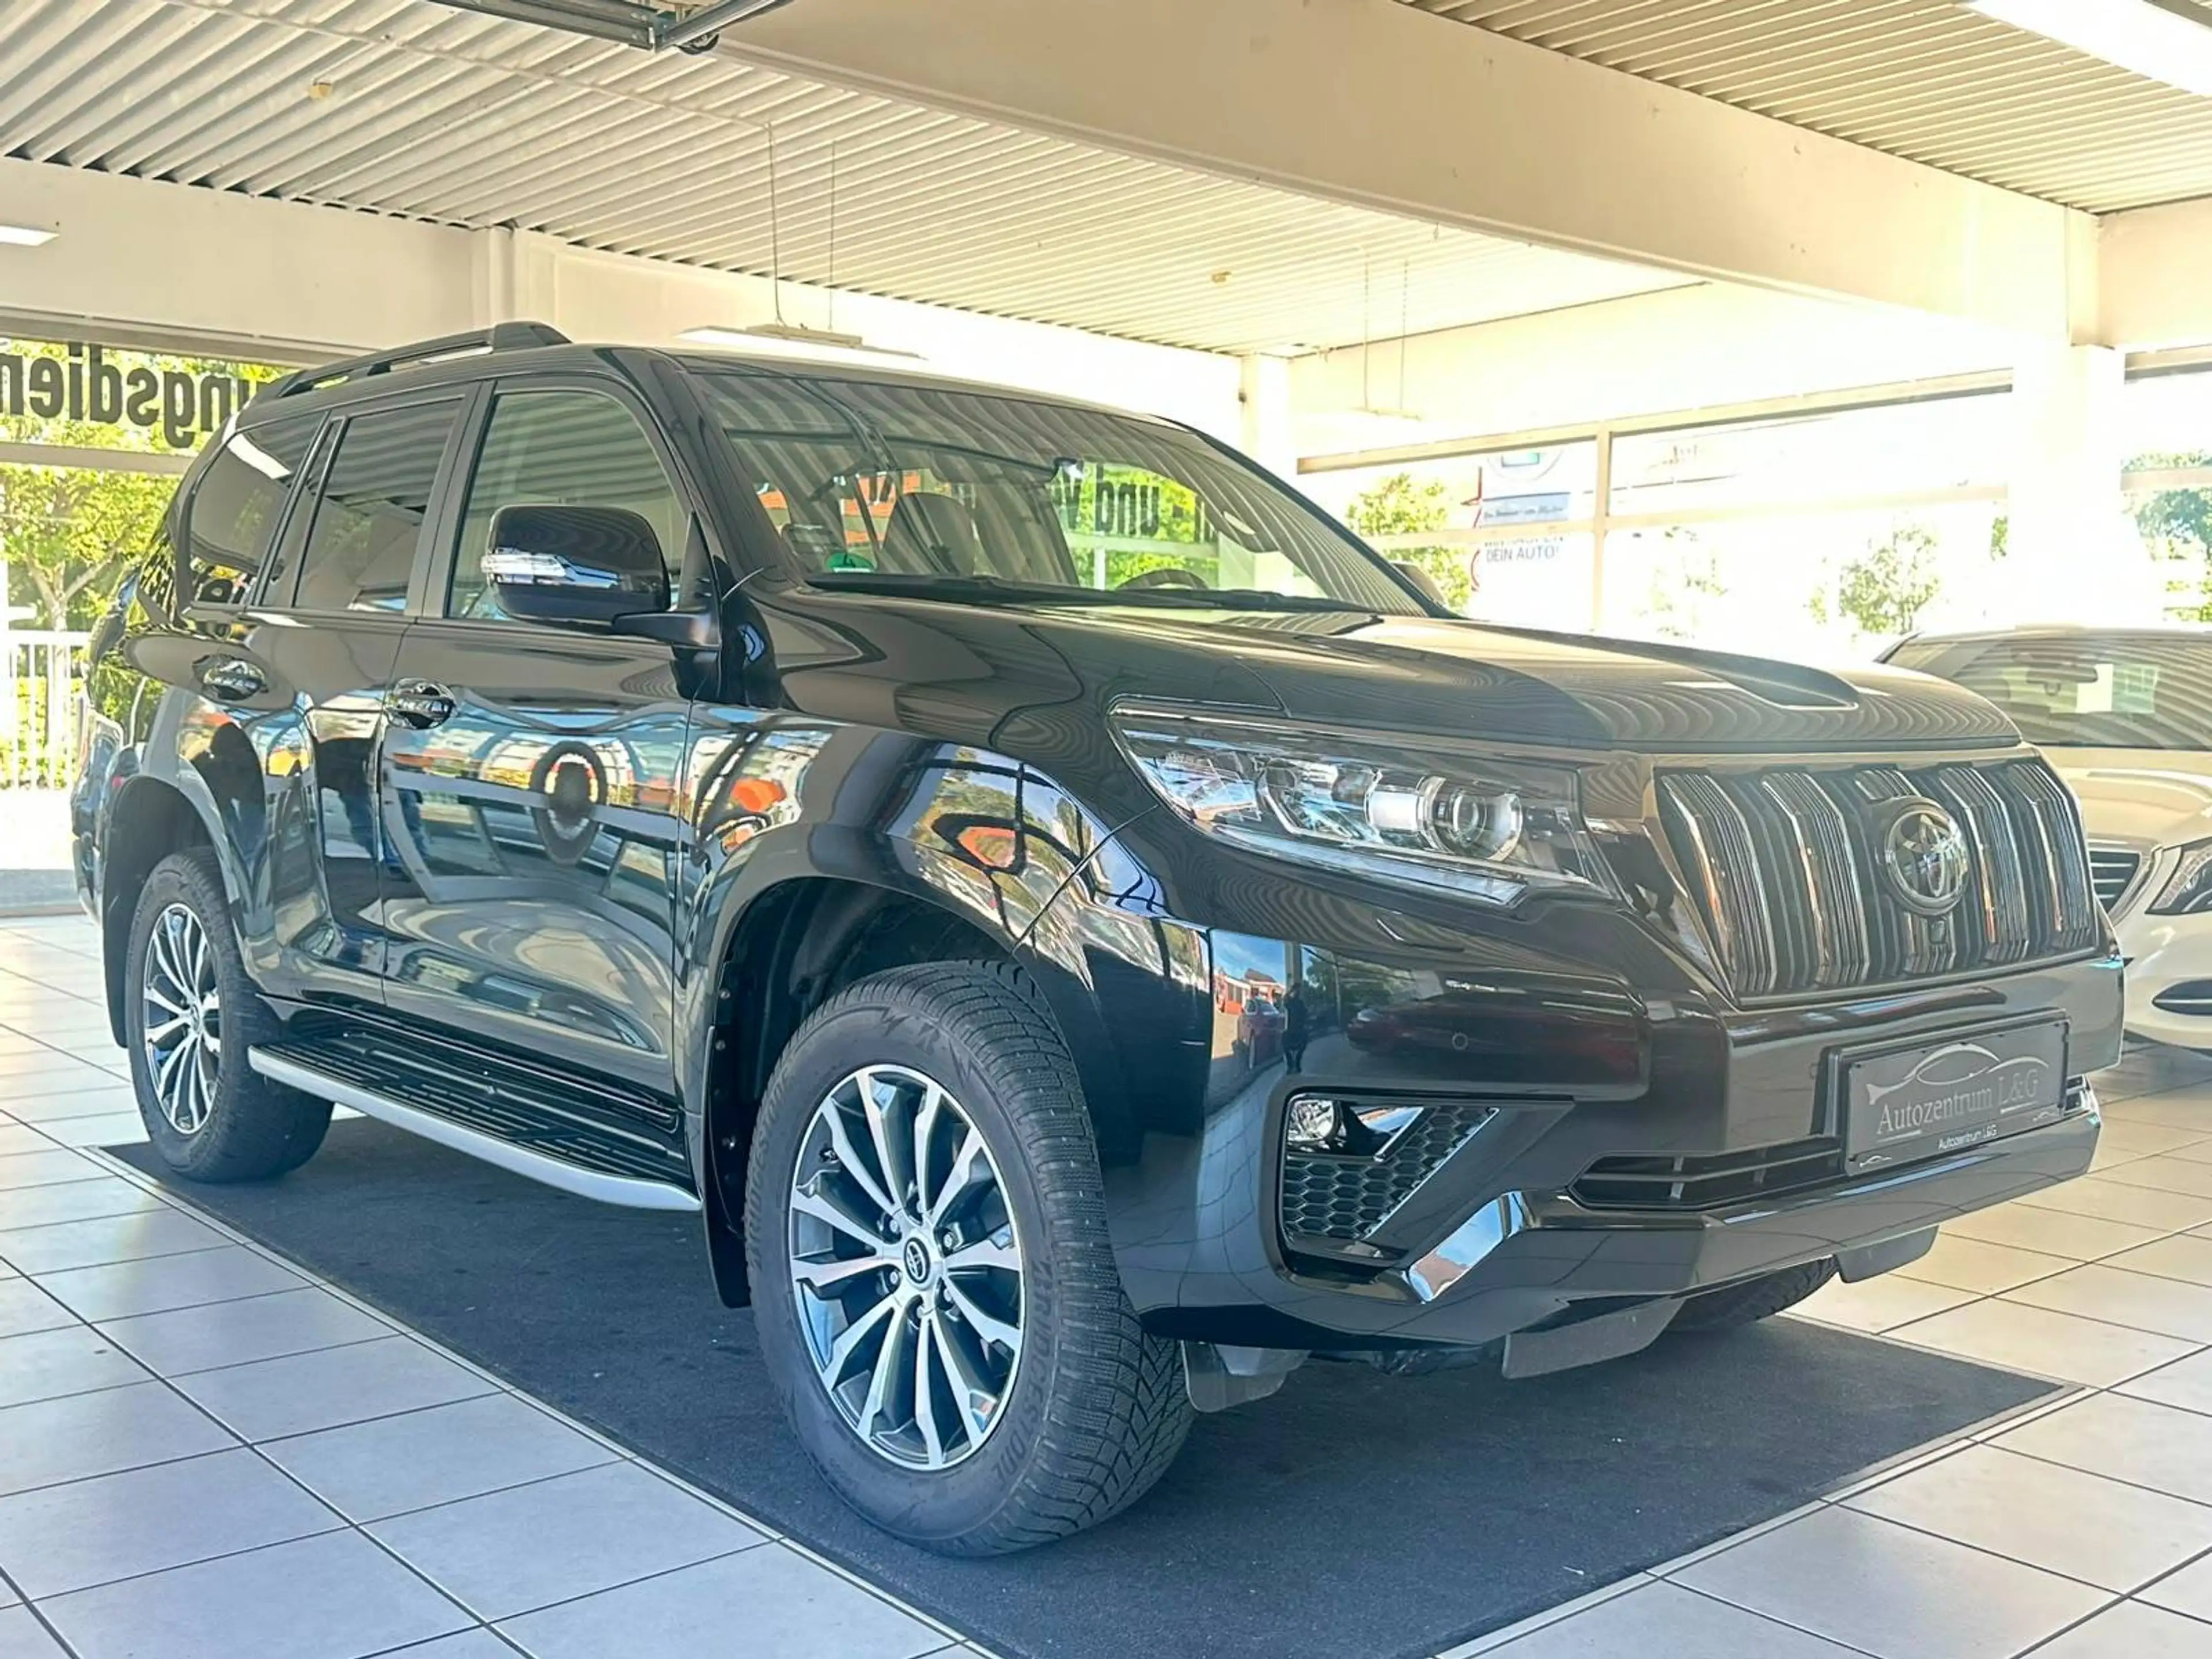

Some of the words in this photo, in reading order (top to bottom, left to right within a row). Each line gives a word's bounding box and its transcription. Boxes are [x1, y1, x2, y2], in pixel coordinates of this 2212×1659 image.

[1486, 548, 1513, 563] DEIN
[1876, 1088, 1992, 1135] Autozentrum
[1997, 1069, 2039, 1105] L&G
